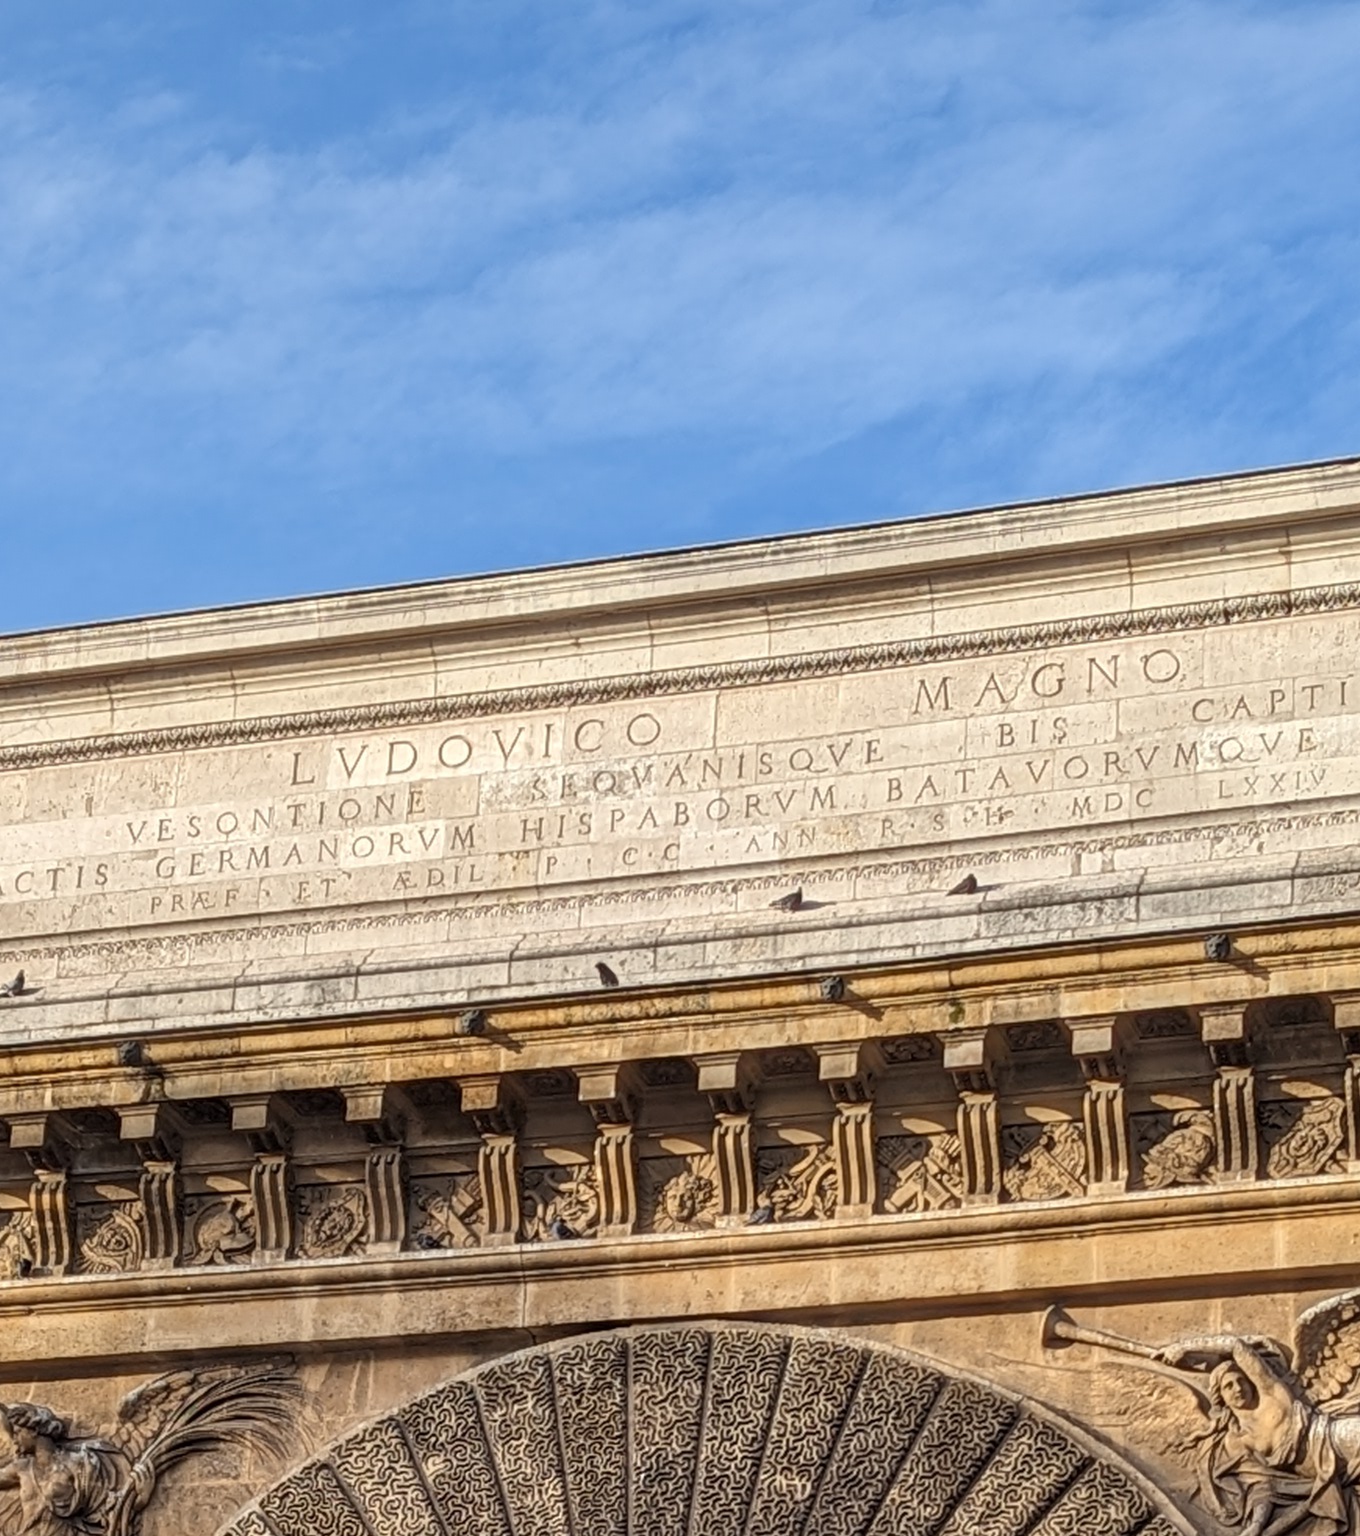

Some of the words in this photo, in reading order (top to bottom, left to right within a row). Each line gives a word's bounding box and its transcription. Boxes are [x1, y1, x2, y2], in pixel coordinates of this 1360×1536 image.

[290, 713, 661, 786] LVDOVICO
[911, 649, 1182, 715] MAGNO
[997, 717, 1068, 749] BIS
[155, 824, 476, 880] GERMANORVM
